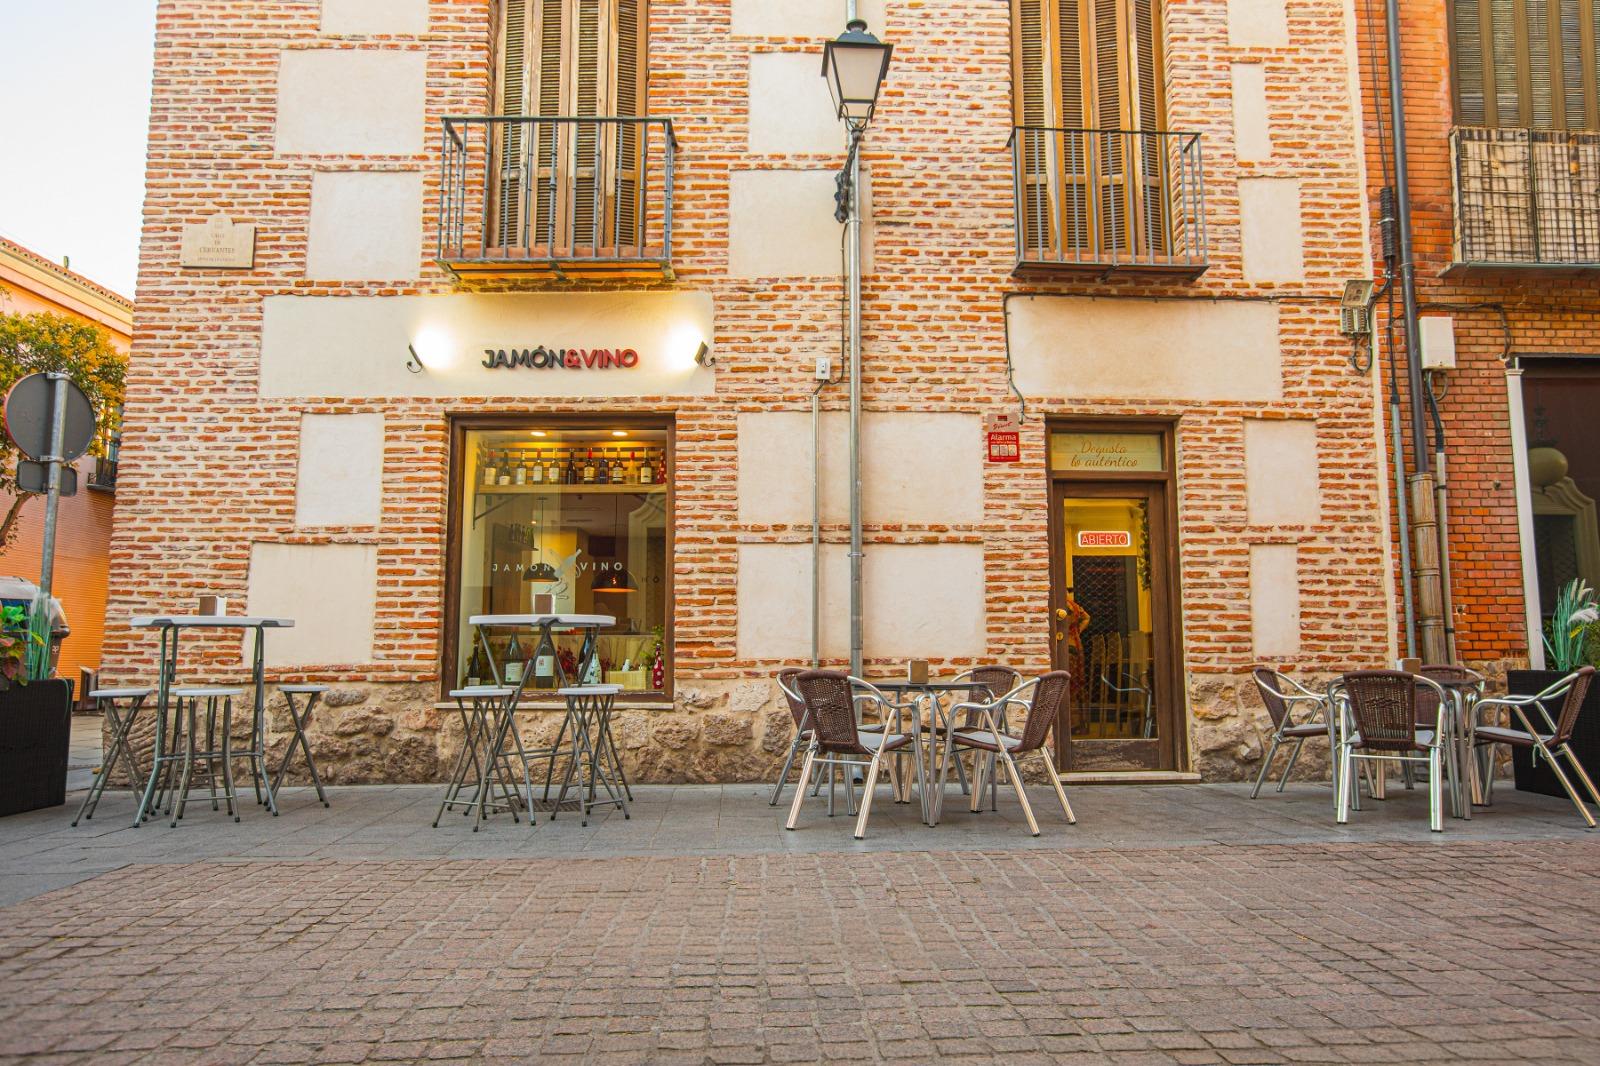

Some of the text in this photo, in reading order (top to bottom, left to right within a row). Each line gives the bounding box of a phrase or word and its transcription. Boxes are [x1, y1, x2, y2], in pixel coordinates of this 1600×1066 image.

[482, 345, 638, 369] JAMÓN&VINO
[1080, 440, 1127, 457] Degusta
[1070, 454, 1138, 467] lo auténtico
[1081, 534, 1127, 545] ABIERTO
[580, 562, 623, 571] VINO
